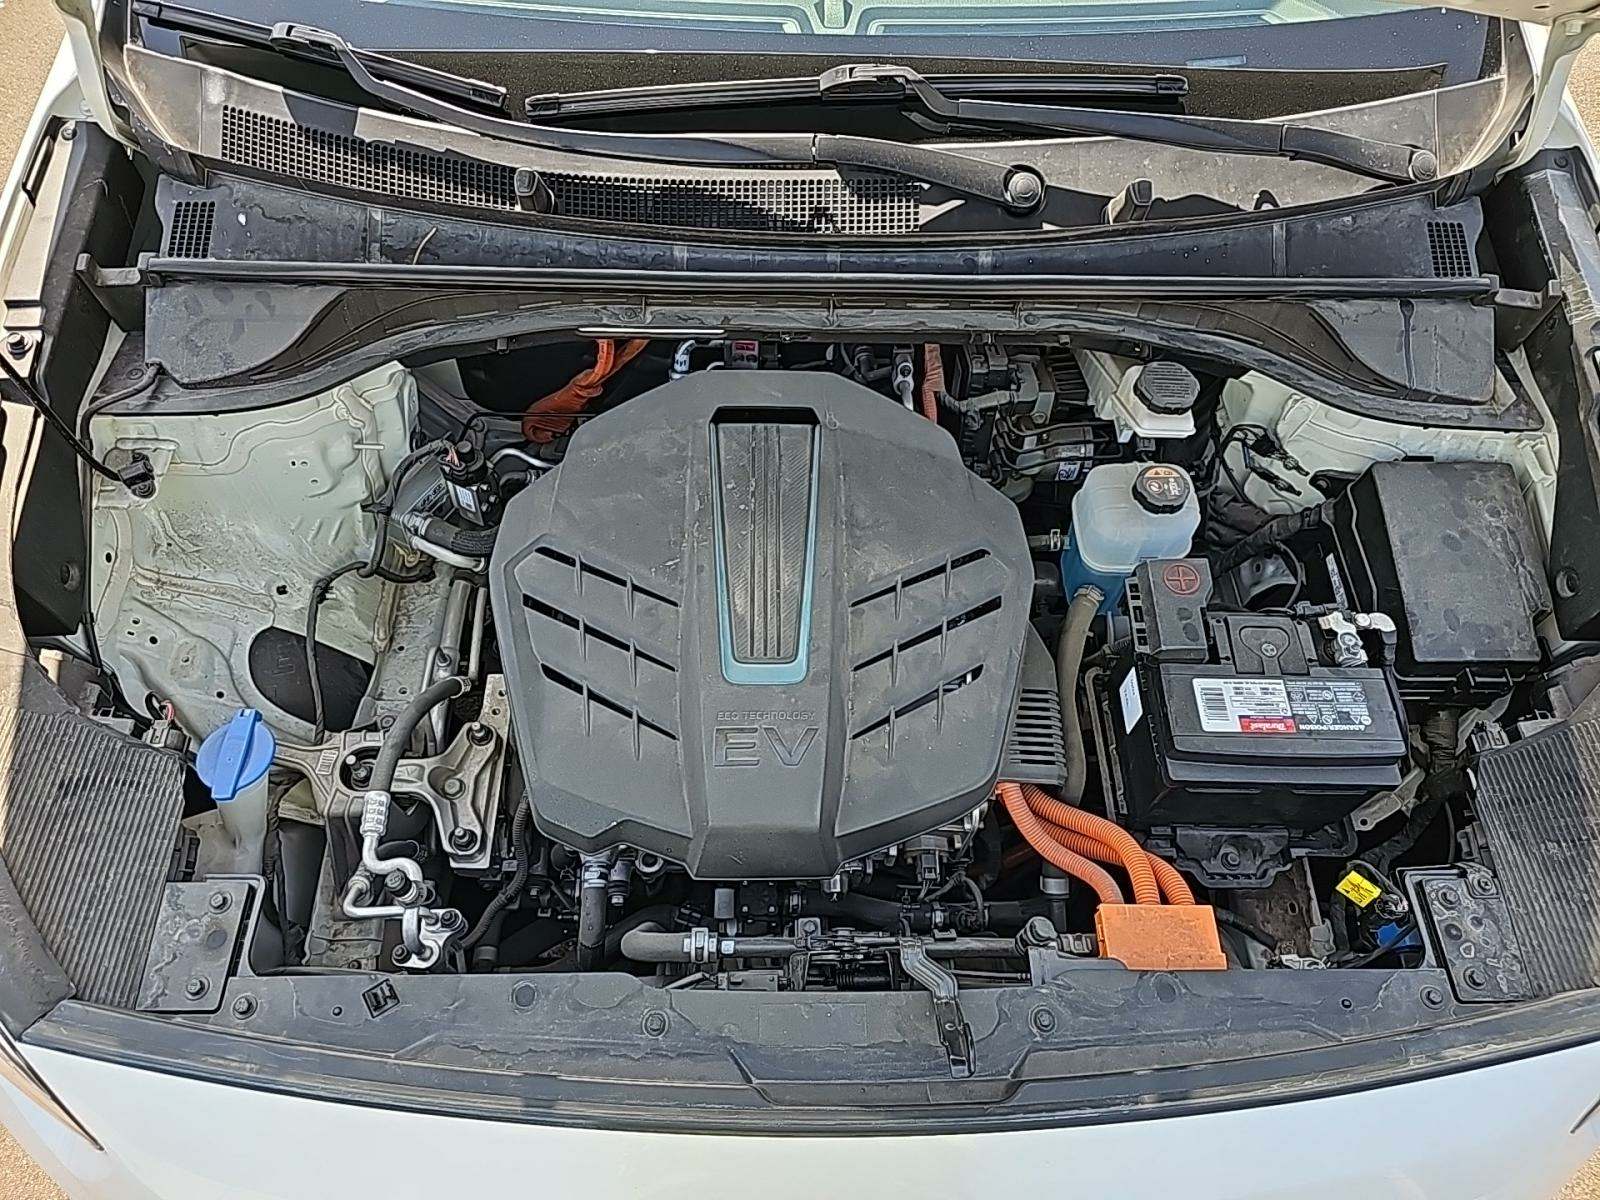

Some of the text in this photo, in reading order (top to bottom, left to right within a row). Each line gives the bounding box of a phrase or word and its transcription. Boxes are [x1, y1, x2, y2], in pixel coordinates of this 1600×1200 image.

[717, 711, 816, 721] ECO TECHNOLOGY
[1249, 722, 1288, 732] Duralast
[713, 726, 820, 767] EV
